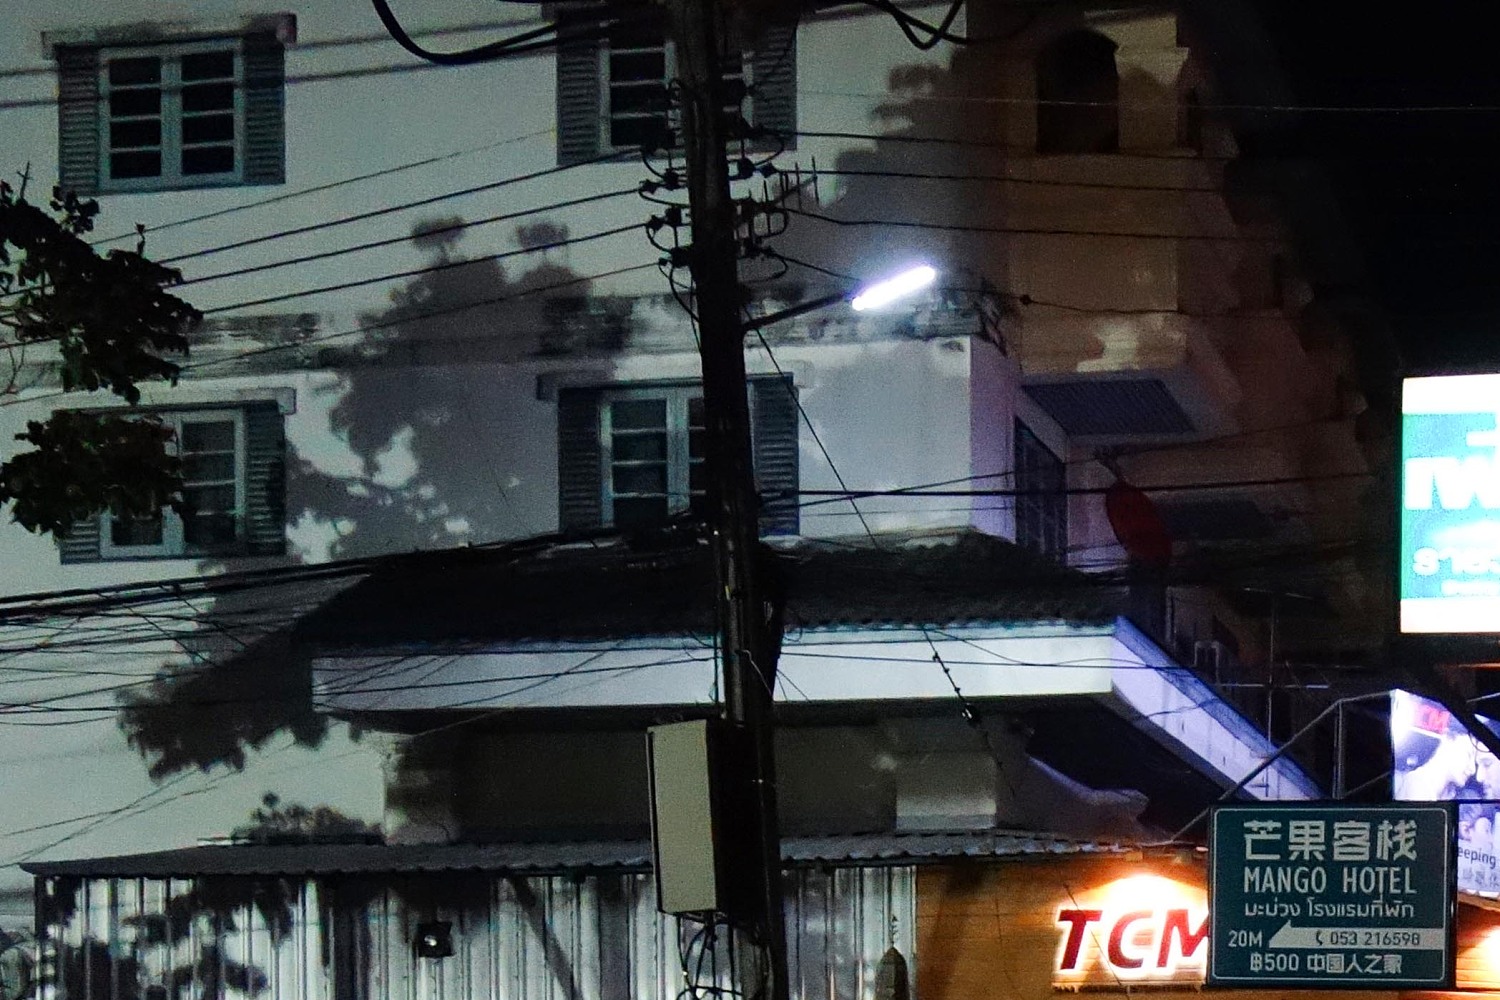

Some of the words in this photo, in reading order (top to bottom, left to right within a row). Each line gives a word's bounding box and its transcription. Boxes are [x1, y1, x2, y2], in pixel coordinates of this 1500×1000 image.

[1243, 819, 1418, 862] 芒果客栈
[1243, 866, 1327, 894] MANGO
[1343, 866, 1418, 894] HOTEL
[1058, 909, 1209, 970] TCM
[1228, 930, 1263, 948] 20M
[1330, 931, 1358, 946] 053
[1364, 931, 1421, 947] 216598
